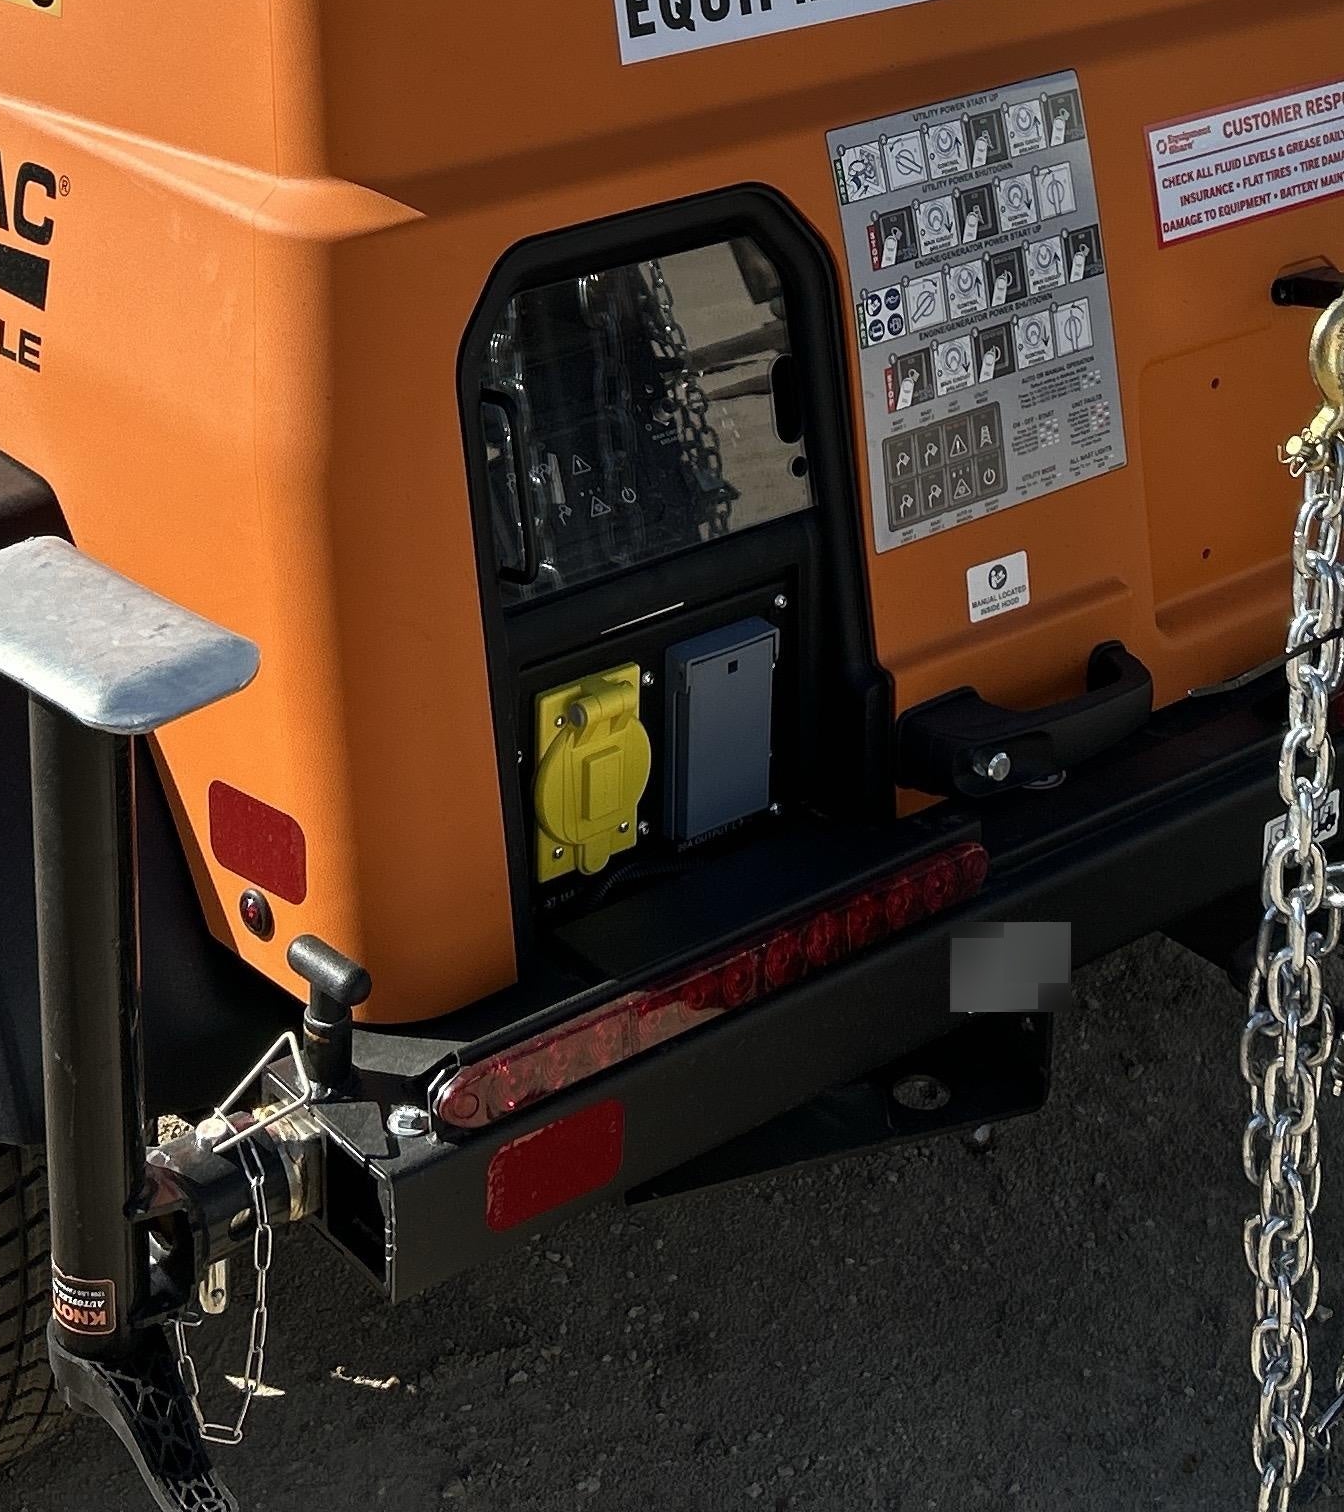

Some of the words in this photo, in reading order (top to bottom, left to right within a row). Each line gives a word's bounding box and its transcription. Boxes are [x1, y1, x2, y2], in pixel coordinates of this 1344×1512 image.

[912, 107, 938, 122] UTILITY
[966, 96, 988, 109] START
[1222, 103, 1303, 139] CUSTOMER
[1162, 170, 1194, 190] CHECK
[1196, 166, 1213, 183] ALL
[1214, 158, 1242, 179] FLUID
[1242, 148, 1276, 169] LEVELS
[1286, 135, 1322, 156] GREASE
[1179, 181, 1235, 207] INSURANCE
[1242, 172, 1264, 190] FLAT
[1265, 165, 1292, 185] TIRES
[1299, 156, 1320, 174] TIRE
[1162, 209, 1203, 234] DAMAGE
[1205, 208, 1217, 222] TO
[1218, 191, 1272, 220] EQUIPMENT
[1279, 178, 1319, 200] BATTERY
[54, 1297, 107, 1326] KNOT
